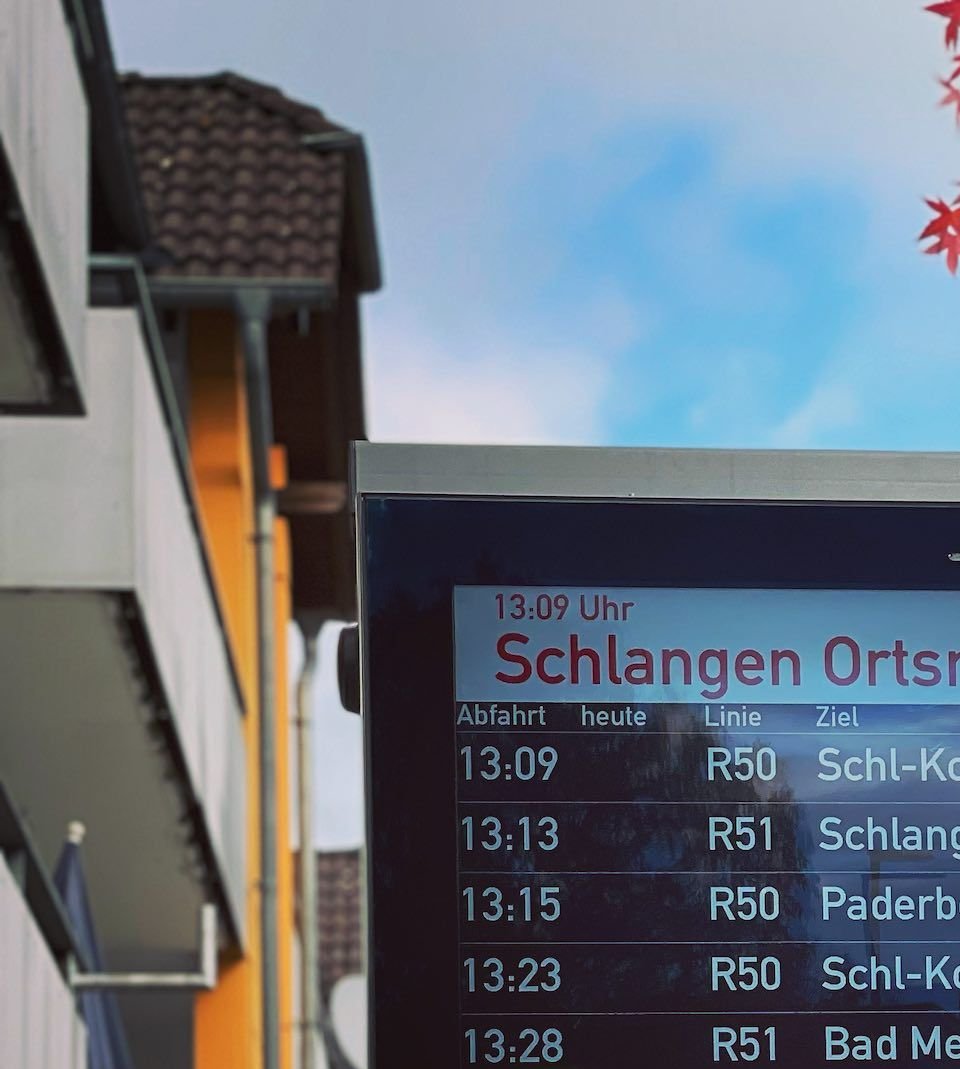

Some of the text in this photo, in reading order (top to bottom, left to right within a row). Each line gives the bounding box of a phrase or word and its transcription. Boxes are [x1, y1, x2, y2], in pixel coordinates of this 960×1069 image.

[495, 593, 635, 622] 13:09 Uhr
[495, 631, 801, 700] Schlangen
[456, 704, 859, 727] Abfahrt heute Linie Ziel
[460, 746, 559, 781] 13:09
[707, 747, 777, 782] R50
[461, 816, 559, 851] 13:13
[708, 816, 773, 851] R51
[462, 886, 561, 922] 13:15
[709, 886, 780, 921] R50
[463, 957, 562, 993] 13:23
[711, 956, 781, 992] R50
[464, 1027, 564, 1064] 13:28
[712, 1026, 777, 1062] R51
[825, 1025, 897, 1061] Bad
